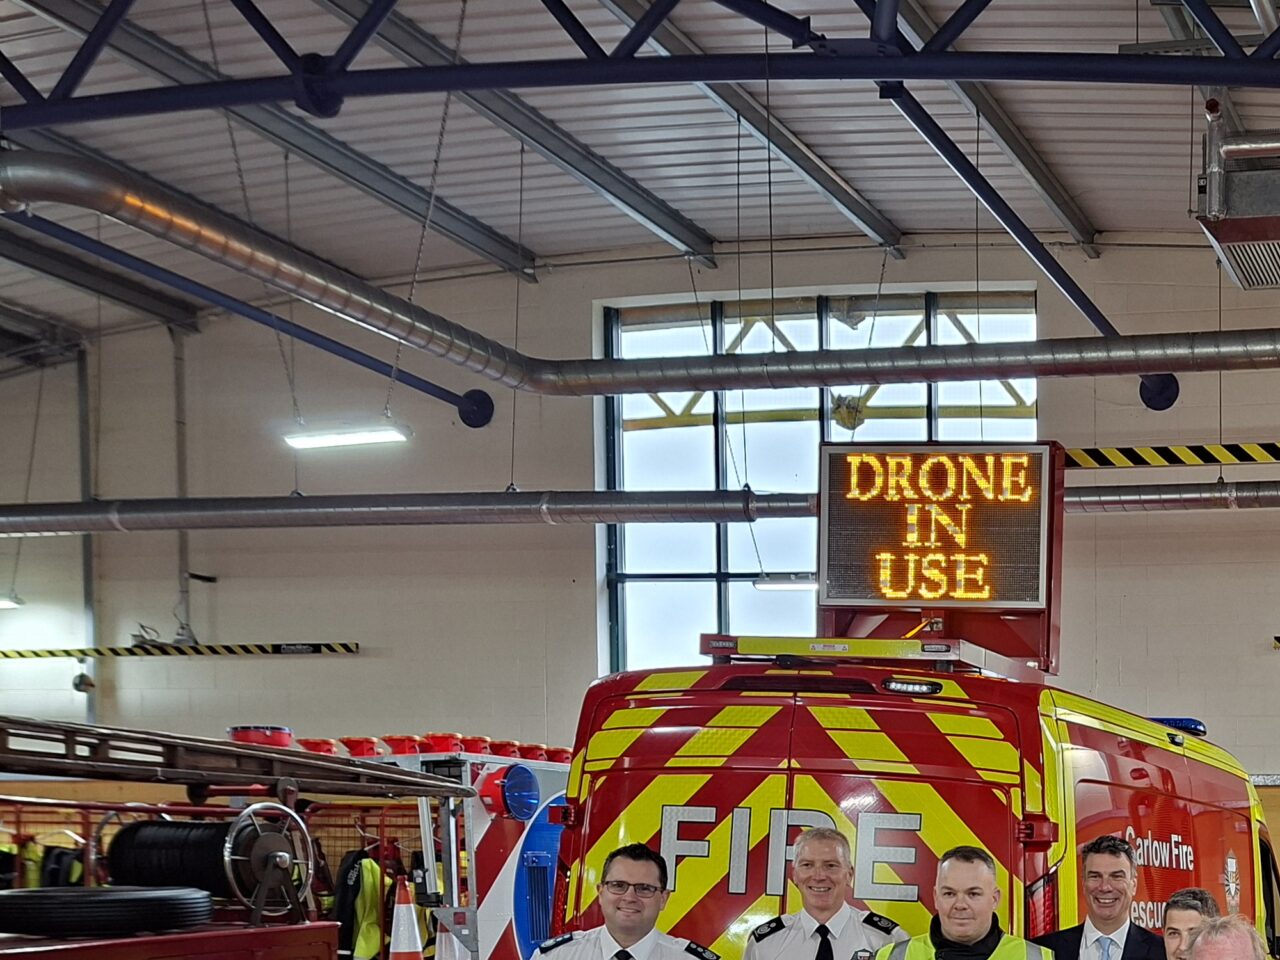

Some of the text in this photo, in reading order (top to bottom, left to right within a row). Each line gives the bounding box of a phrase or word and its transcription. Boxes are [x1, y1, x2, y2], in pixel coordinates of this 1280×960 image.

[846, 454, 1033, 502] DRONE
[902, 503, 972, 549] IN
[875, 552, 990, 599] USE
[659, 804, 922, 902] FIRE
[1171, 833, 1194, 871] Fire
[1130, 900, 1167, 928] escu
